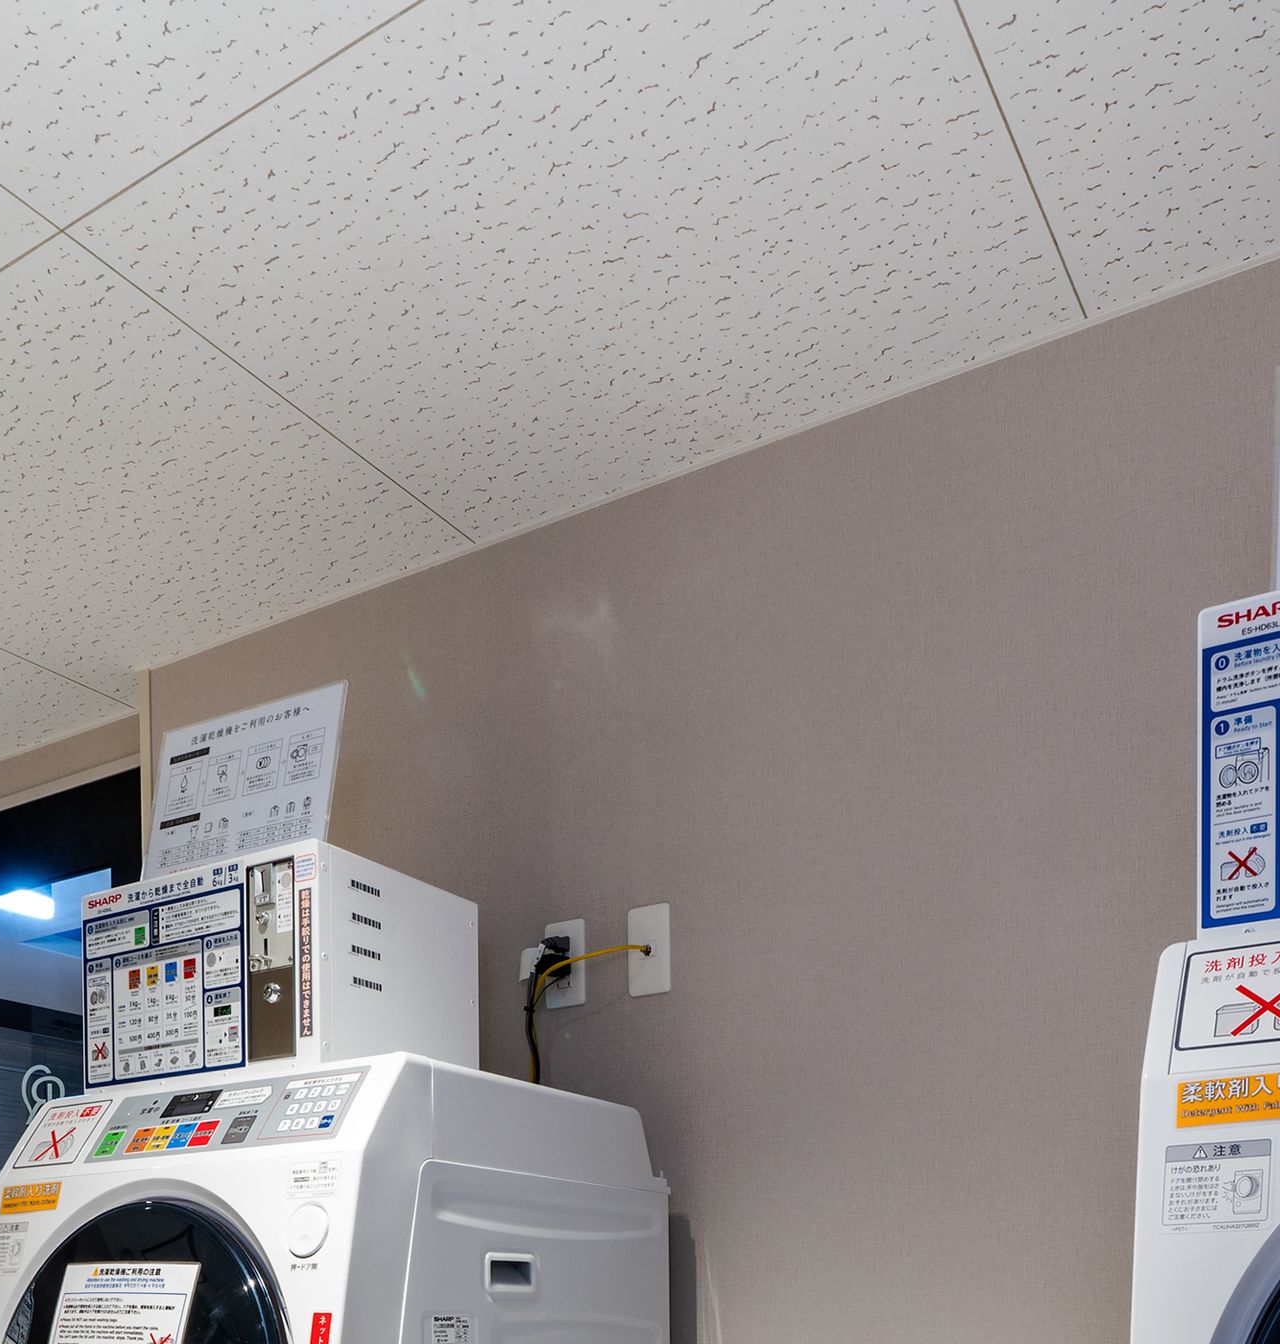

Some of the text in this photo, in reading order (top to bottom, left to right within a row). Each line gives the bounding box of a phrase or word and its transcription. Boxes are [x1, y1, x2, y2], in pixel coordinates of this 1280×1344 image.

[127, 876, 205, 904] 洗濯から乾燥まで全自動
[87, 893, 122, 910] SHARP
[300, 888, 312, 1037] 乾燥は手絞りでの使用はできません
[1181, 1104, 1234, 1119] Detergent
[1235, 1102, 1259, 1112] With
[1213, 1144, 1242, 1157] 注意
[3, 1182, 59, 1200] 柔軟剤入り洗剤
[98, 1267, 161, 1277] 洗濯乾燥機ご利用の注意
